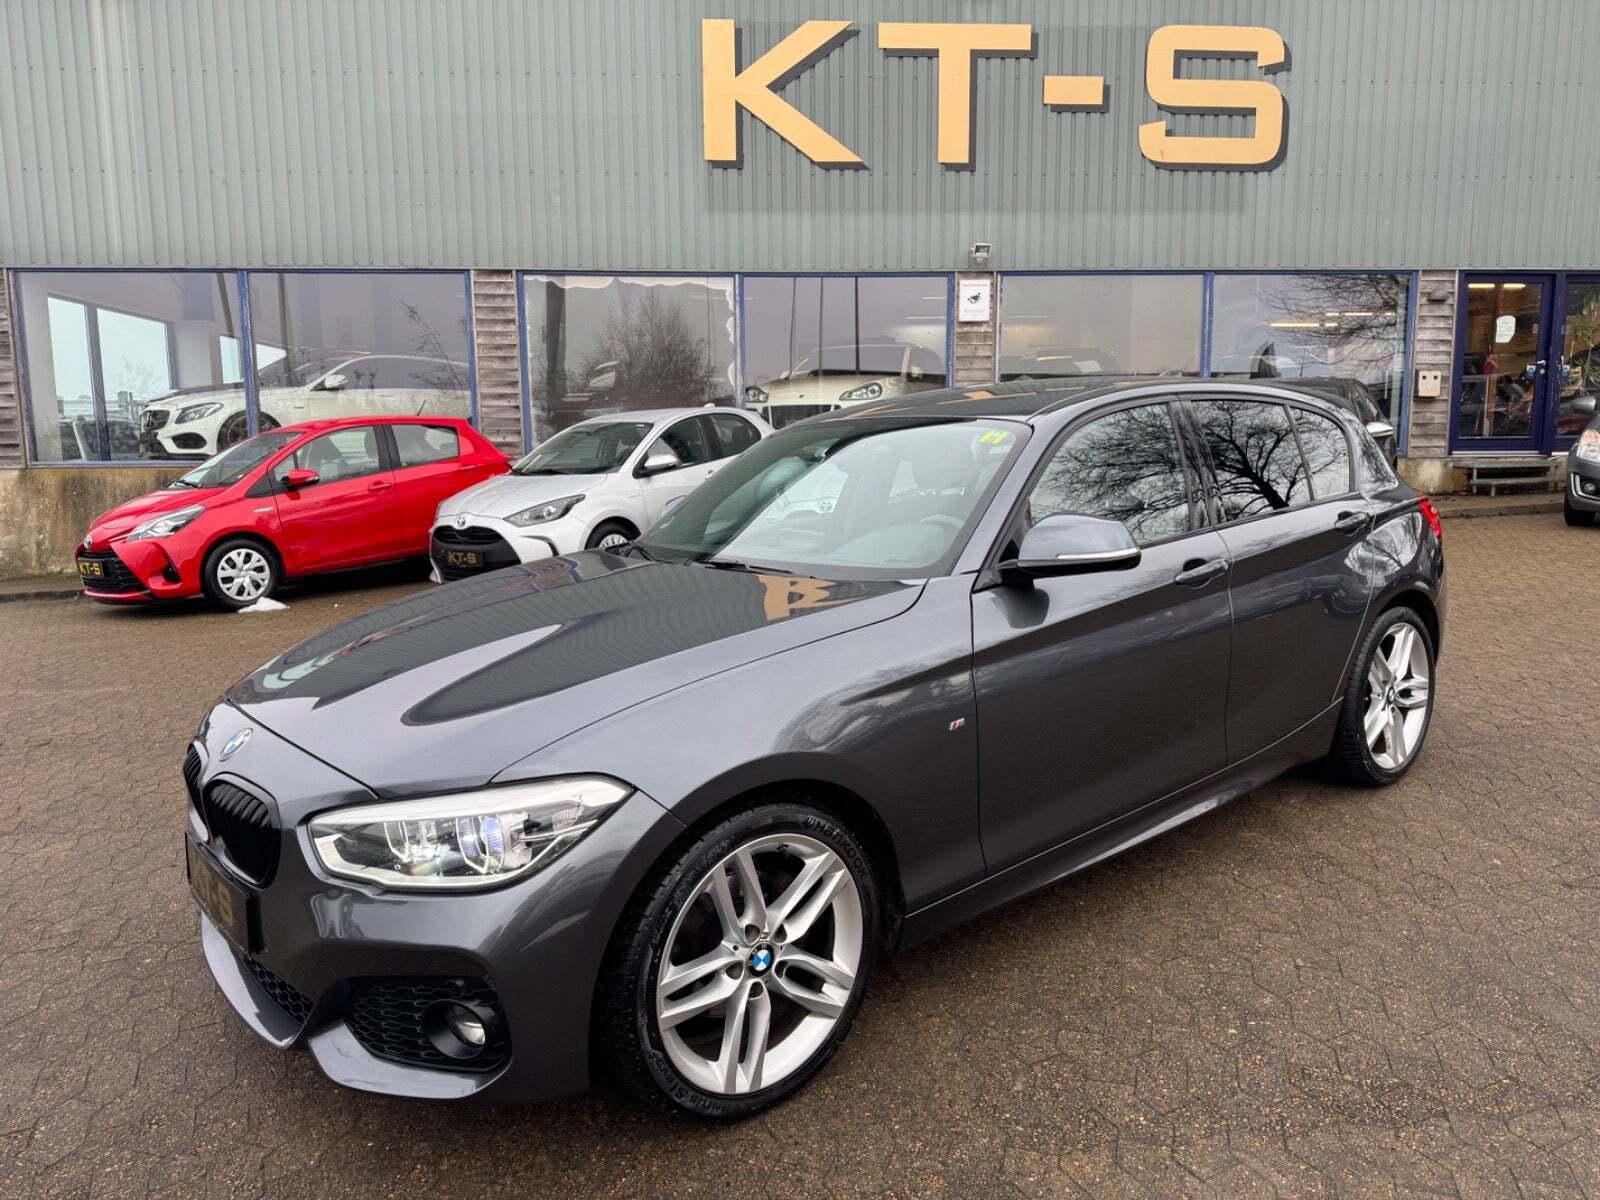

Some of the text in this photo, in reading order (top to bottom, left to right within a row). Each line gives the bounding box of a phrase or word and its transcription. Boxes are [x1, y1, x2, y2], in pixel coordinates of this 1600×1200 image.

[702, 19, 1285, 164] KT-S
[448, 551, 477, 565] KT-S
[80, 561, 101, 577] KT-S
